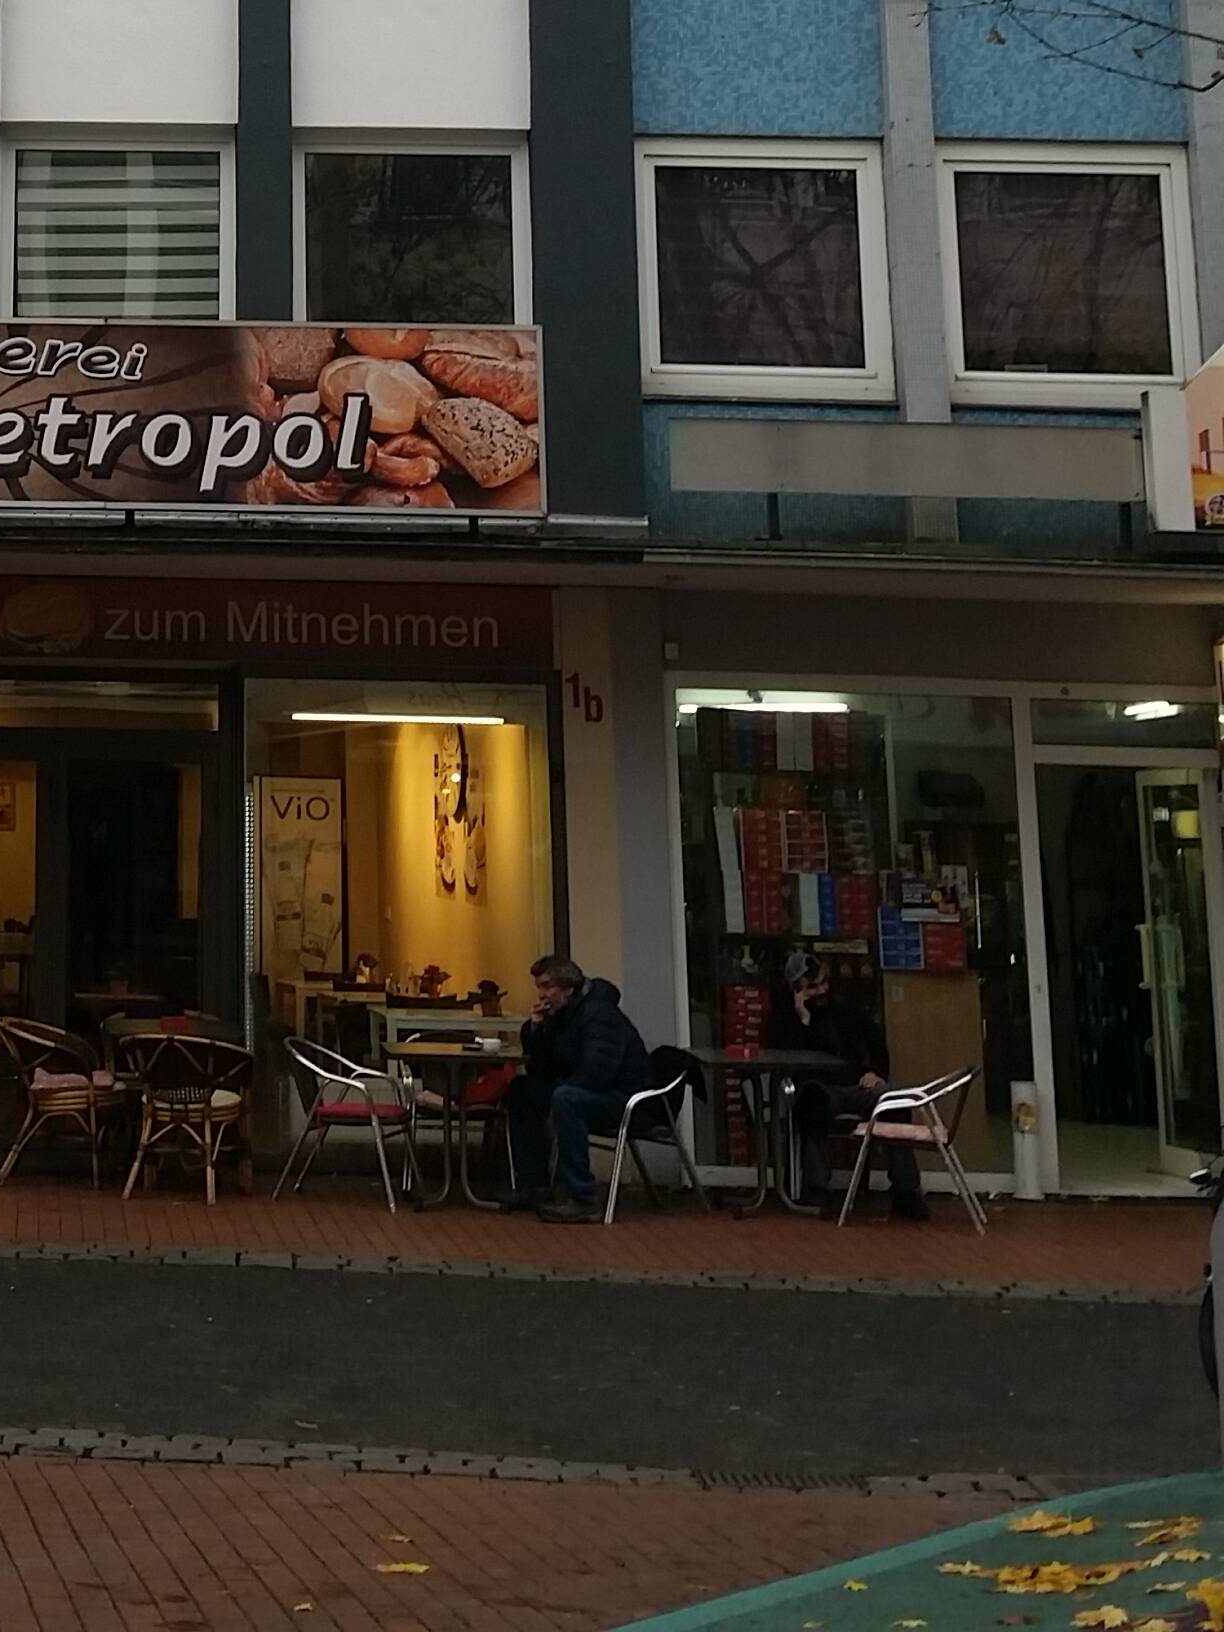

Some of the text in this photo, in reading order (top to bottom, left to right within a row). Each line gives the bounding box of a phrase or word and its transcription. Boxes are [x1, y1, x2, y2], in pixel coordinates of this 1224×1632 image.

[104, 604, 206, 644] zum
[226, 599, 501, 649] Mitnehmen
[563, 671, 604, 723] 1b
[270, 794, 330, 821] ViO
